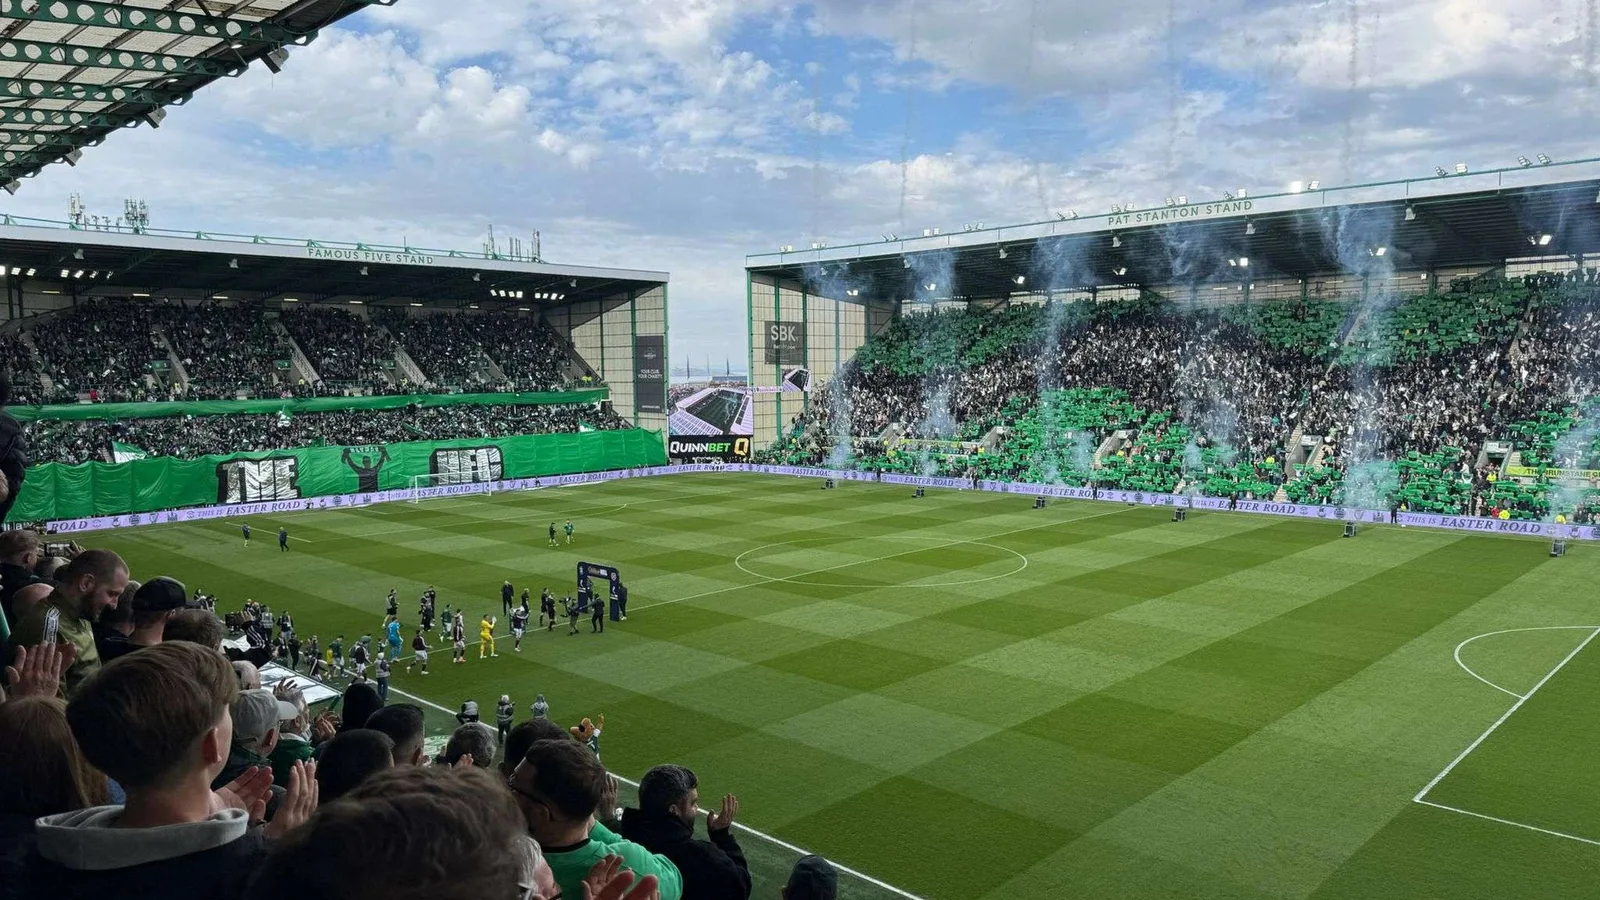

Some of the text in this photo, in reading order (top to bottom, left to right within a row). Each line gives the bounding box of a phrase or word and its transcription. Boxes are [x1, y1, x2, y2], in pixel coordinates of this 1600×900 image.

[1108, 201, 1252, 226] PAT STANTON STAND
[308, 248, 434, 264] FAMOUS FIVE STAND
[770, 324, 796, 341] SBK
[670, 441, 731, 453] QUINNBET
[734, 438, 749, 455] Q
[219, 457, 300, 504] THE
[559, 475, 585, 484] EASTER
[586, 473, 607, 482] ROAD
[904, 476, 931, 485] EASTER
[932, 478, 954, 487] ROAD
[409, 486, 444, 498] EASTER
[447, 486, 471, 495] ROAD
[1043, 486, 1075, 496] EASTER
[197, 510, 216, 518] THIS
[226, 504, 267, 515] EASTER
[271, 500, 300, 511] ROAD
[1263, 503, 1296, 514] ROAD
[51, 521, 88, 531] ROAD
[1407, 515, 1426, 524] THIS
[1440, 517, 1494, 530] EASTER
[1499, 520, 1541, 534] ROAD
